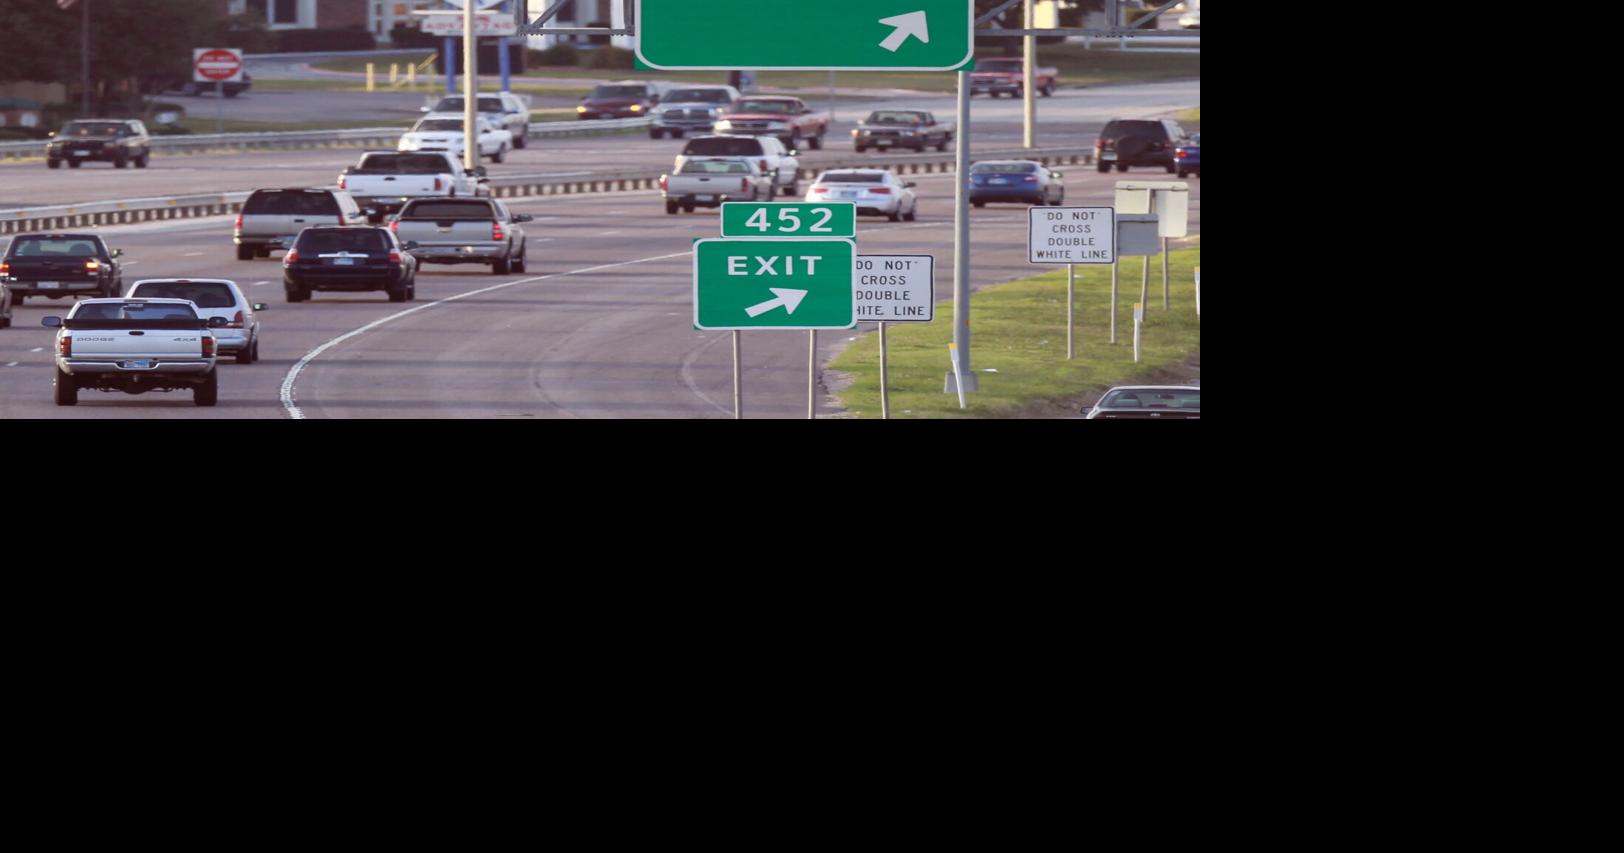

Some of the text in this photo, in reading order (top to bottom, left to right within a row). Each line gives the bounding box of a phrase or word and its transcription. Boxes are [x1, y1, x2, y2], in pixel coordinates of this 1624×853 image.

[744, 207, 833, 232] 452
[1047, 212, 1096, 220] DO NOT
[1052, 225, 1091, 233] CROSS
[1048, 238, 1095, 246] DOUBLE
[1036, 250, 1108, 259] WHITE LINE
[727, 255, 823, 276] EXIT
[856, 260, 912, 270] DO NOT
[861, 275, 907, 285] CROSS
[856, 290, 911, 301] DOUBLE
[894, 306, 926, 316] LINE
